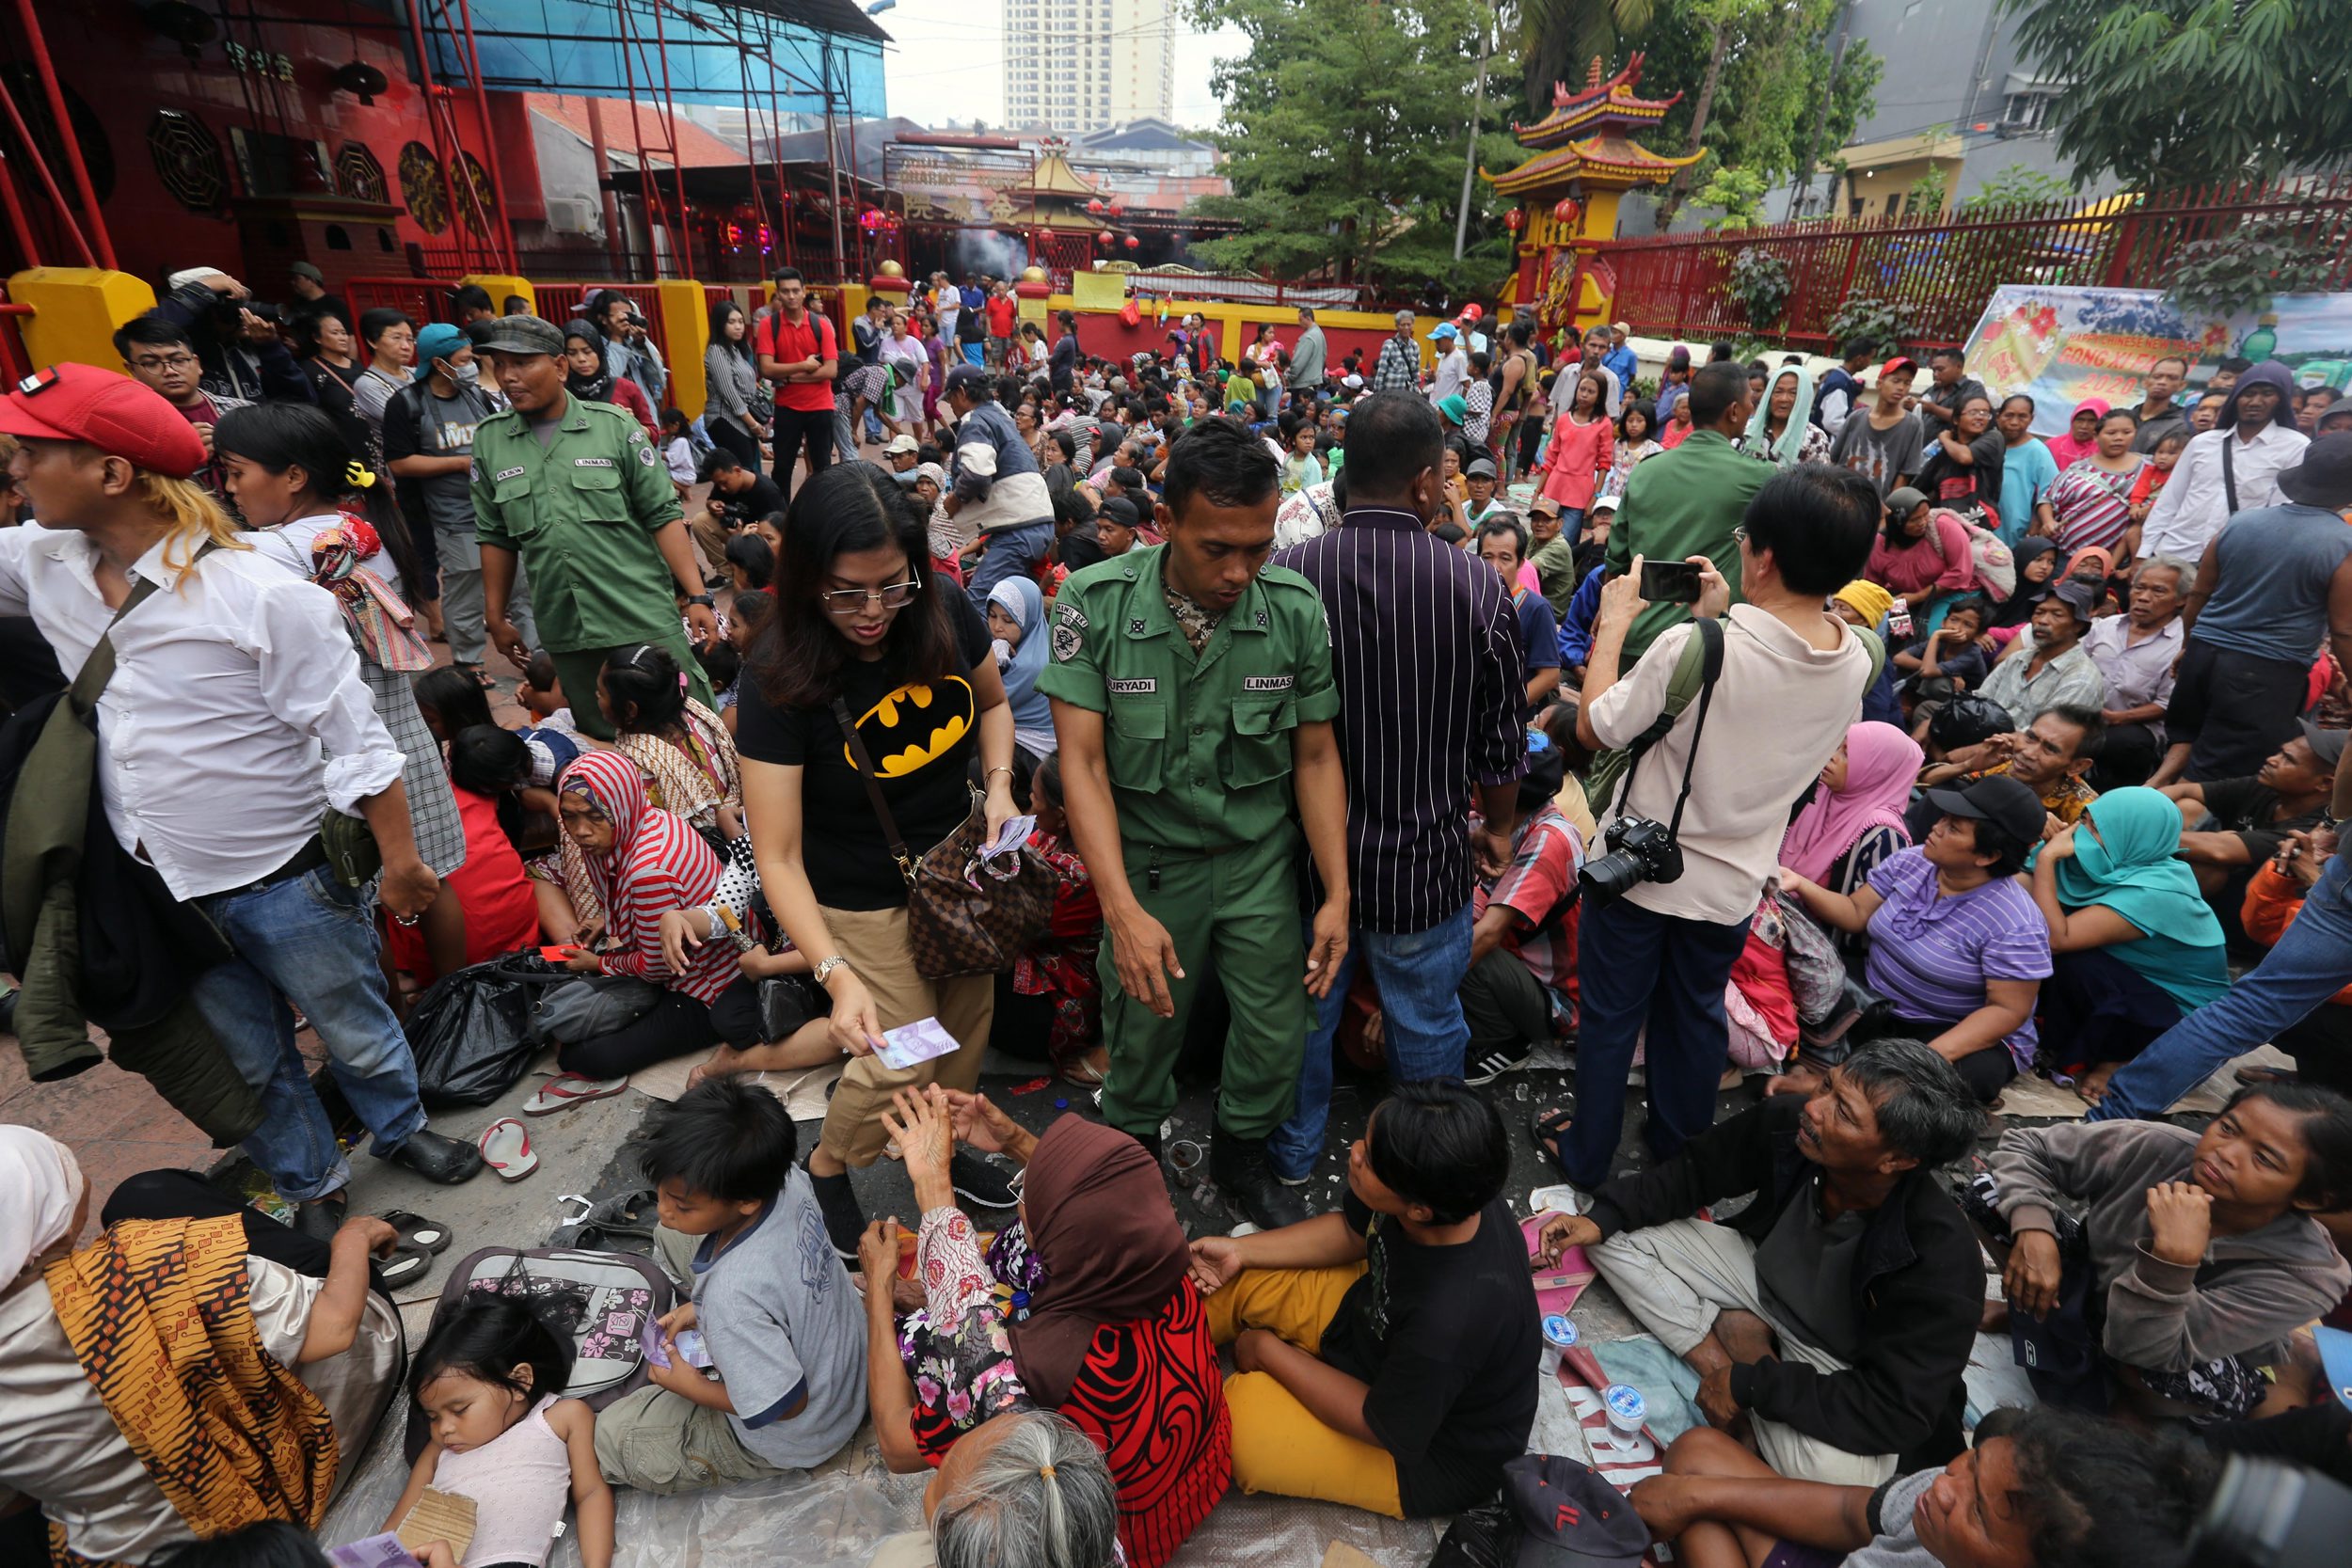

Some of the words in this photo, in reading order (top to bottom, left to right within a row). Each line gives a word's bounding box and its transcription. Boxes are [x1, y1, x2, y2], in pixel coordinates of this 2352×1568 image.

[2069, 332, 2100, 345] HAPPY
[2102, 334, 2144, 348] CHINESE
[2146, 337, 2169, 351] NEW
[2172, 340, 2202, 353] YEAR
[2058, 346, 2109, 368] GONG
[2108, 350, 2132, 370] XI
[2079, 373, 2137, 395] 2020
[576, 458, 612, 467] LINMAS
[1246, 676, 1293, 689] LINMAS
